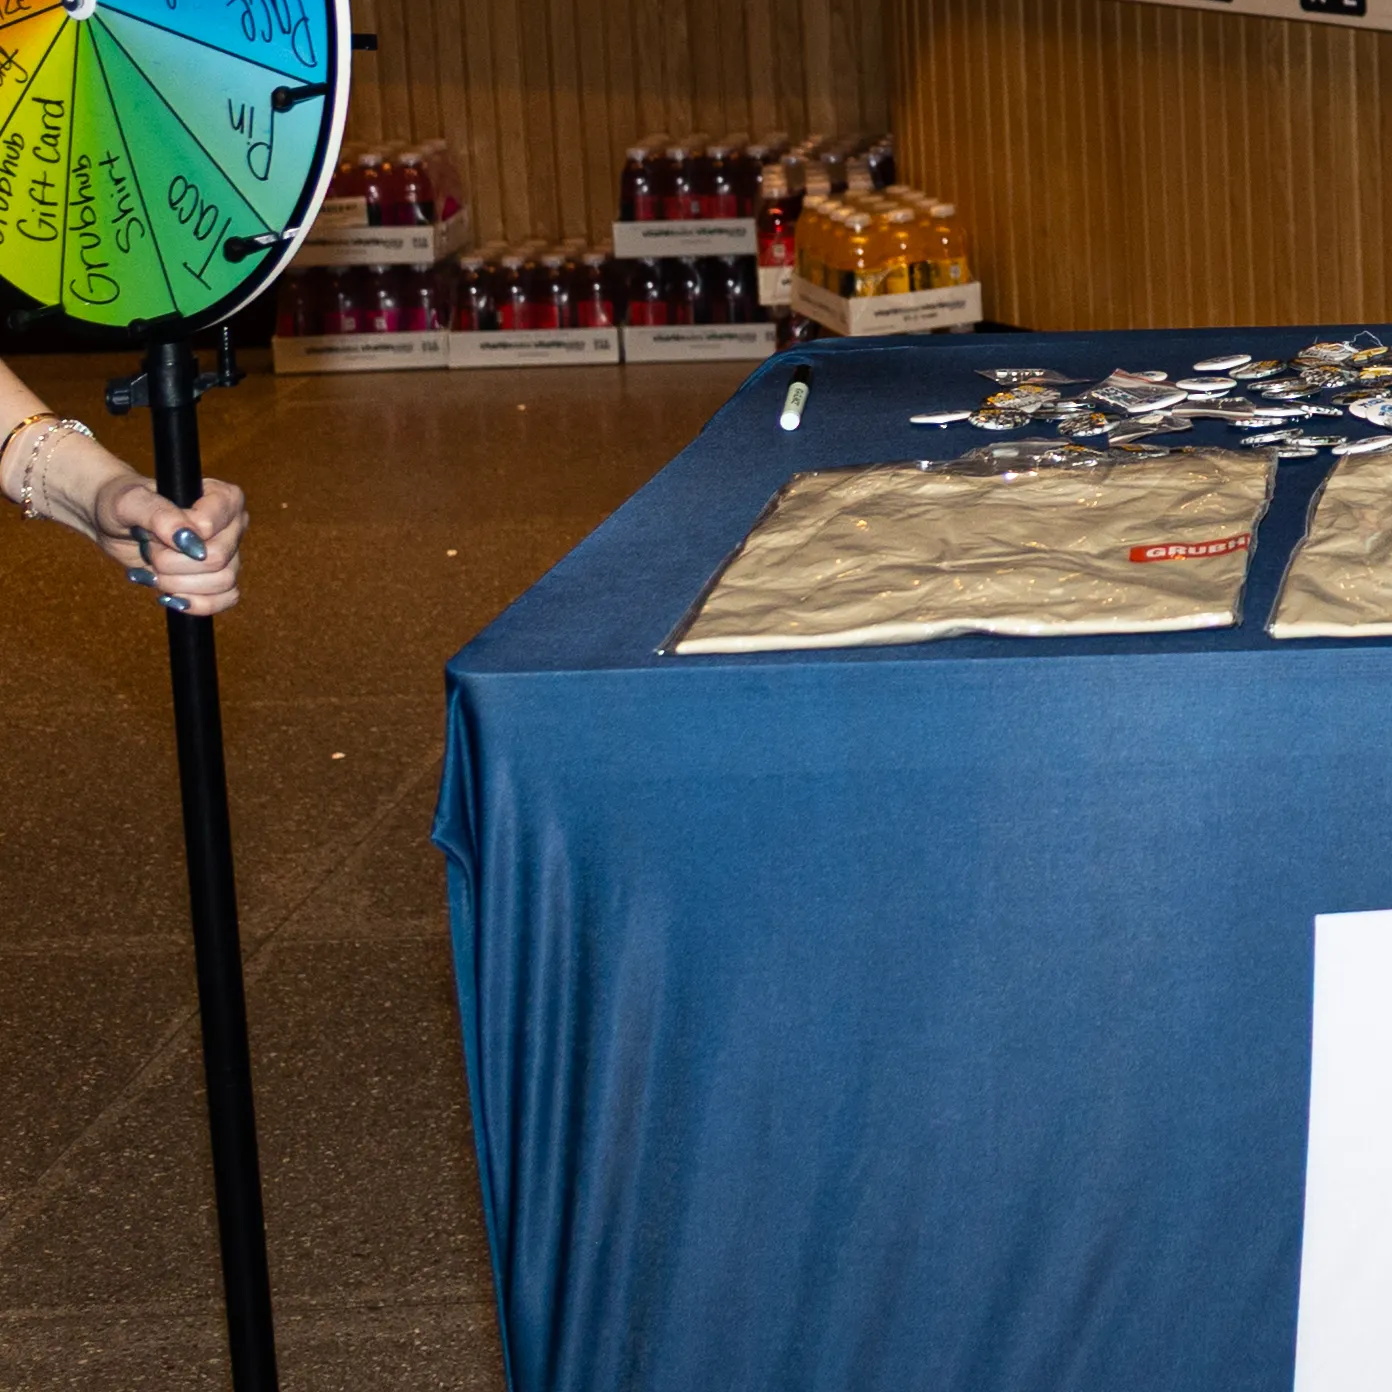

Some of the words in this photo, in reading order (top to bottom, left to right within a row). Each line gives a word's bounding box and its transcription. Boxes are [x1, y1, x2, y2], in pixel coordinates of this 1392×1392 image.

[32, 97, 65, 164] Card
[228, 98, 275, 181] Pin
[16, 170, 59, 242] Gift
[70, 154, 120, 306] Grubhub
[99, 150, 145, 254] Shirt
[1145, 536, 1247, 559] GRUBH
